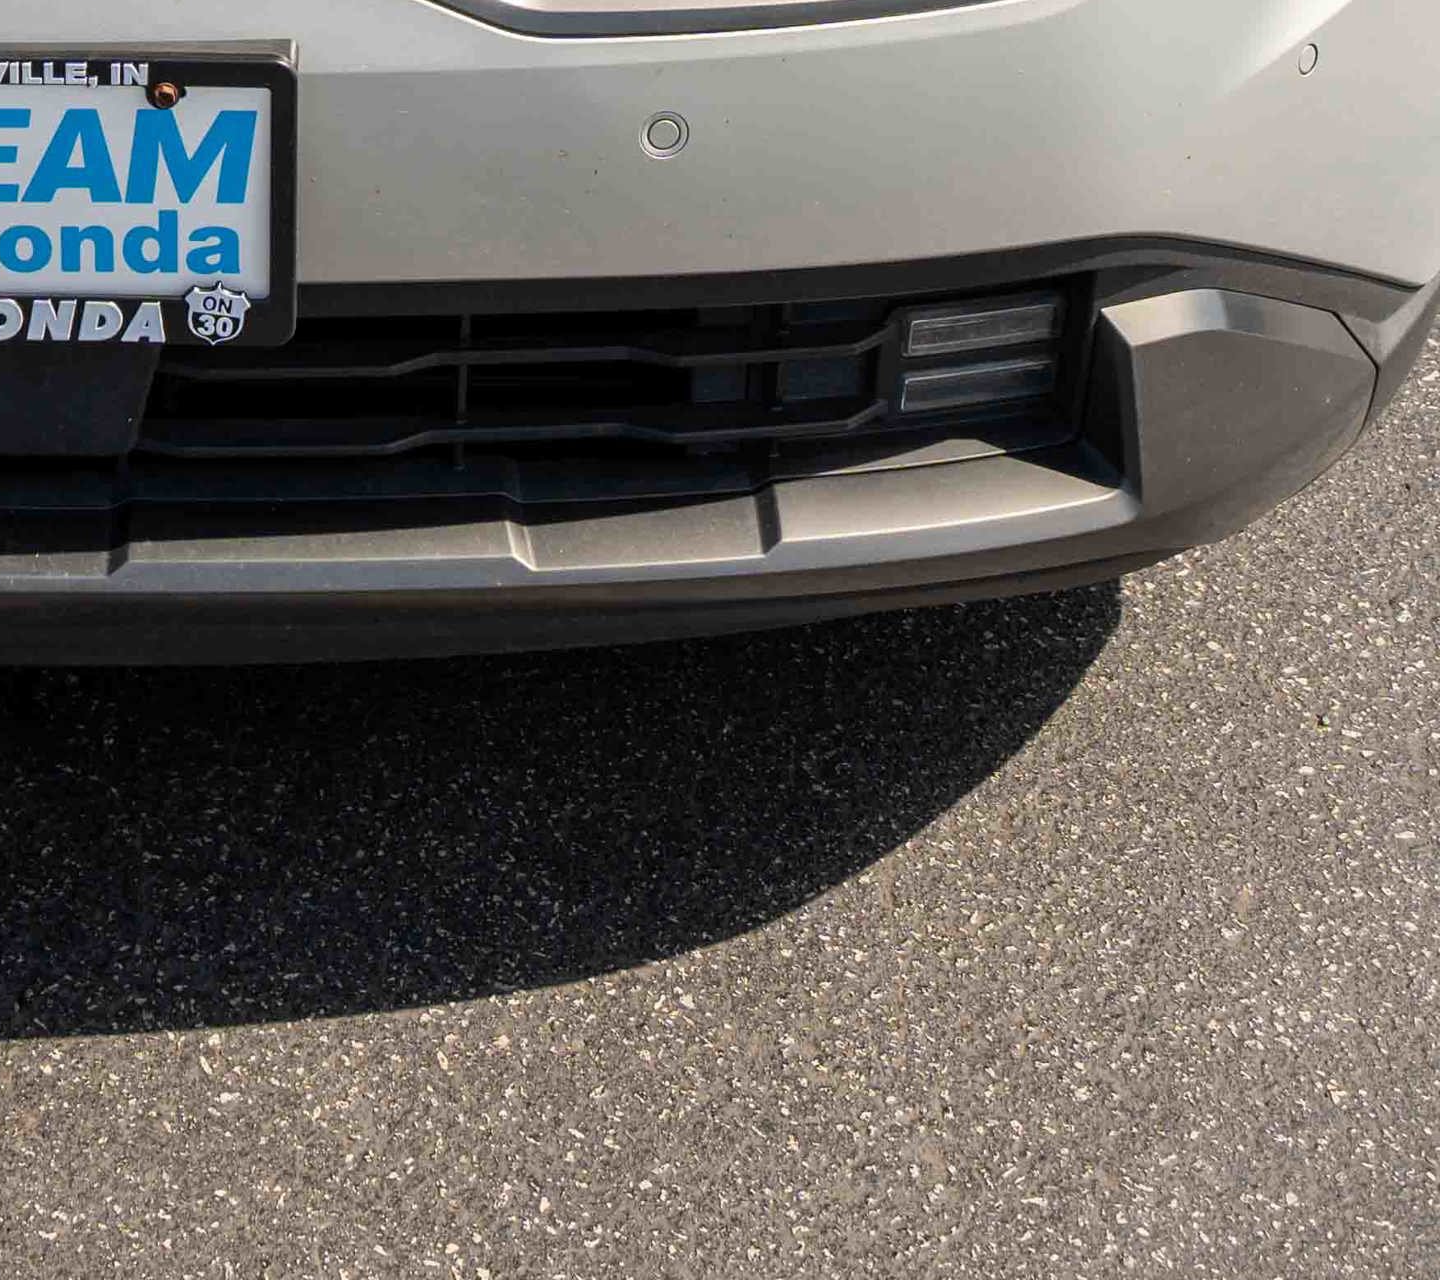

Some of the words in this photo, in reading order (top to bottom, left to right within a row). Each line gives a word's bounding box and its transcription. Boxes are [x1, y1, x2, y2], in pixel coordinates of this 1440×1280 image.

[111, 62, 150, 86] IN
[202, 296, 233, 314] ON
[197, 314, 233, 337] 30
